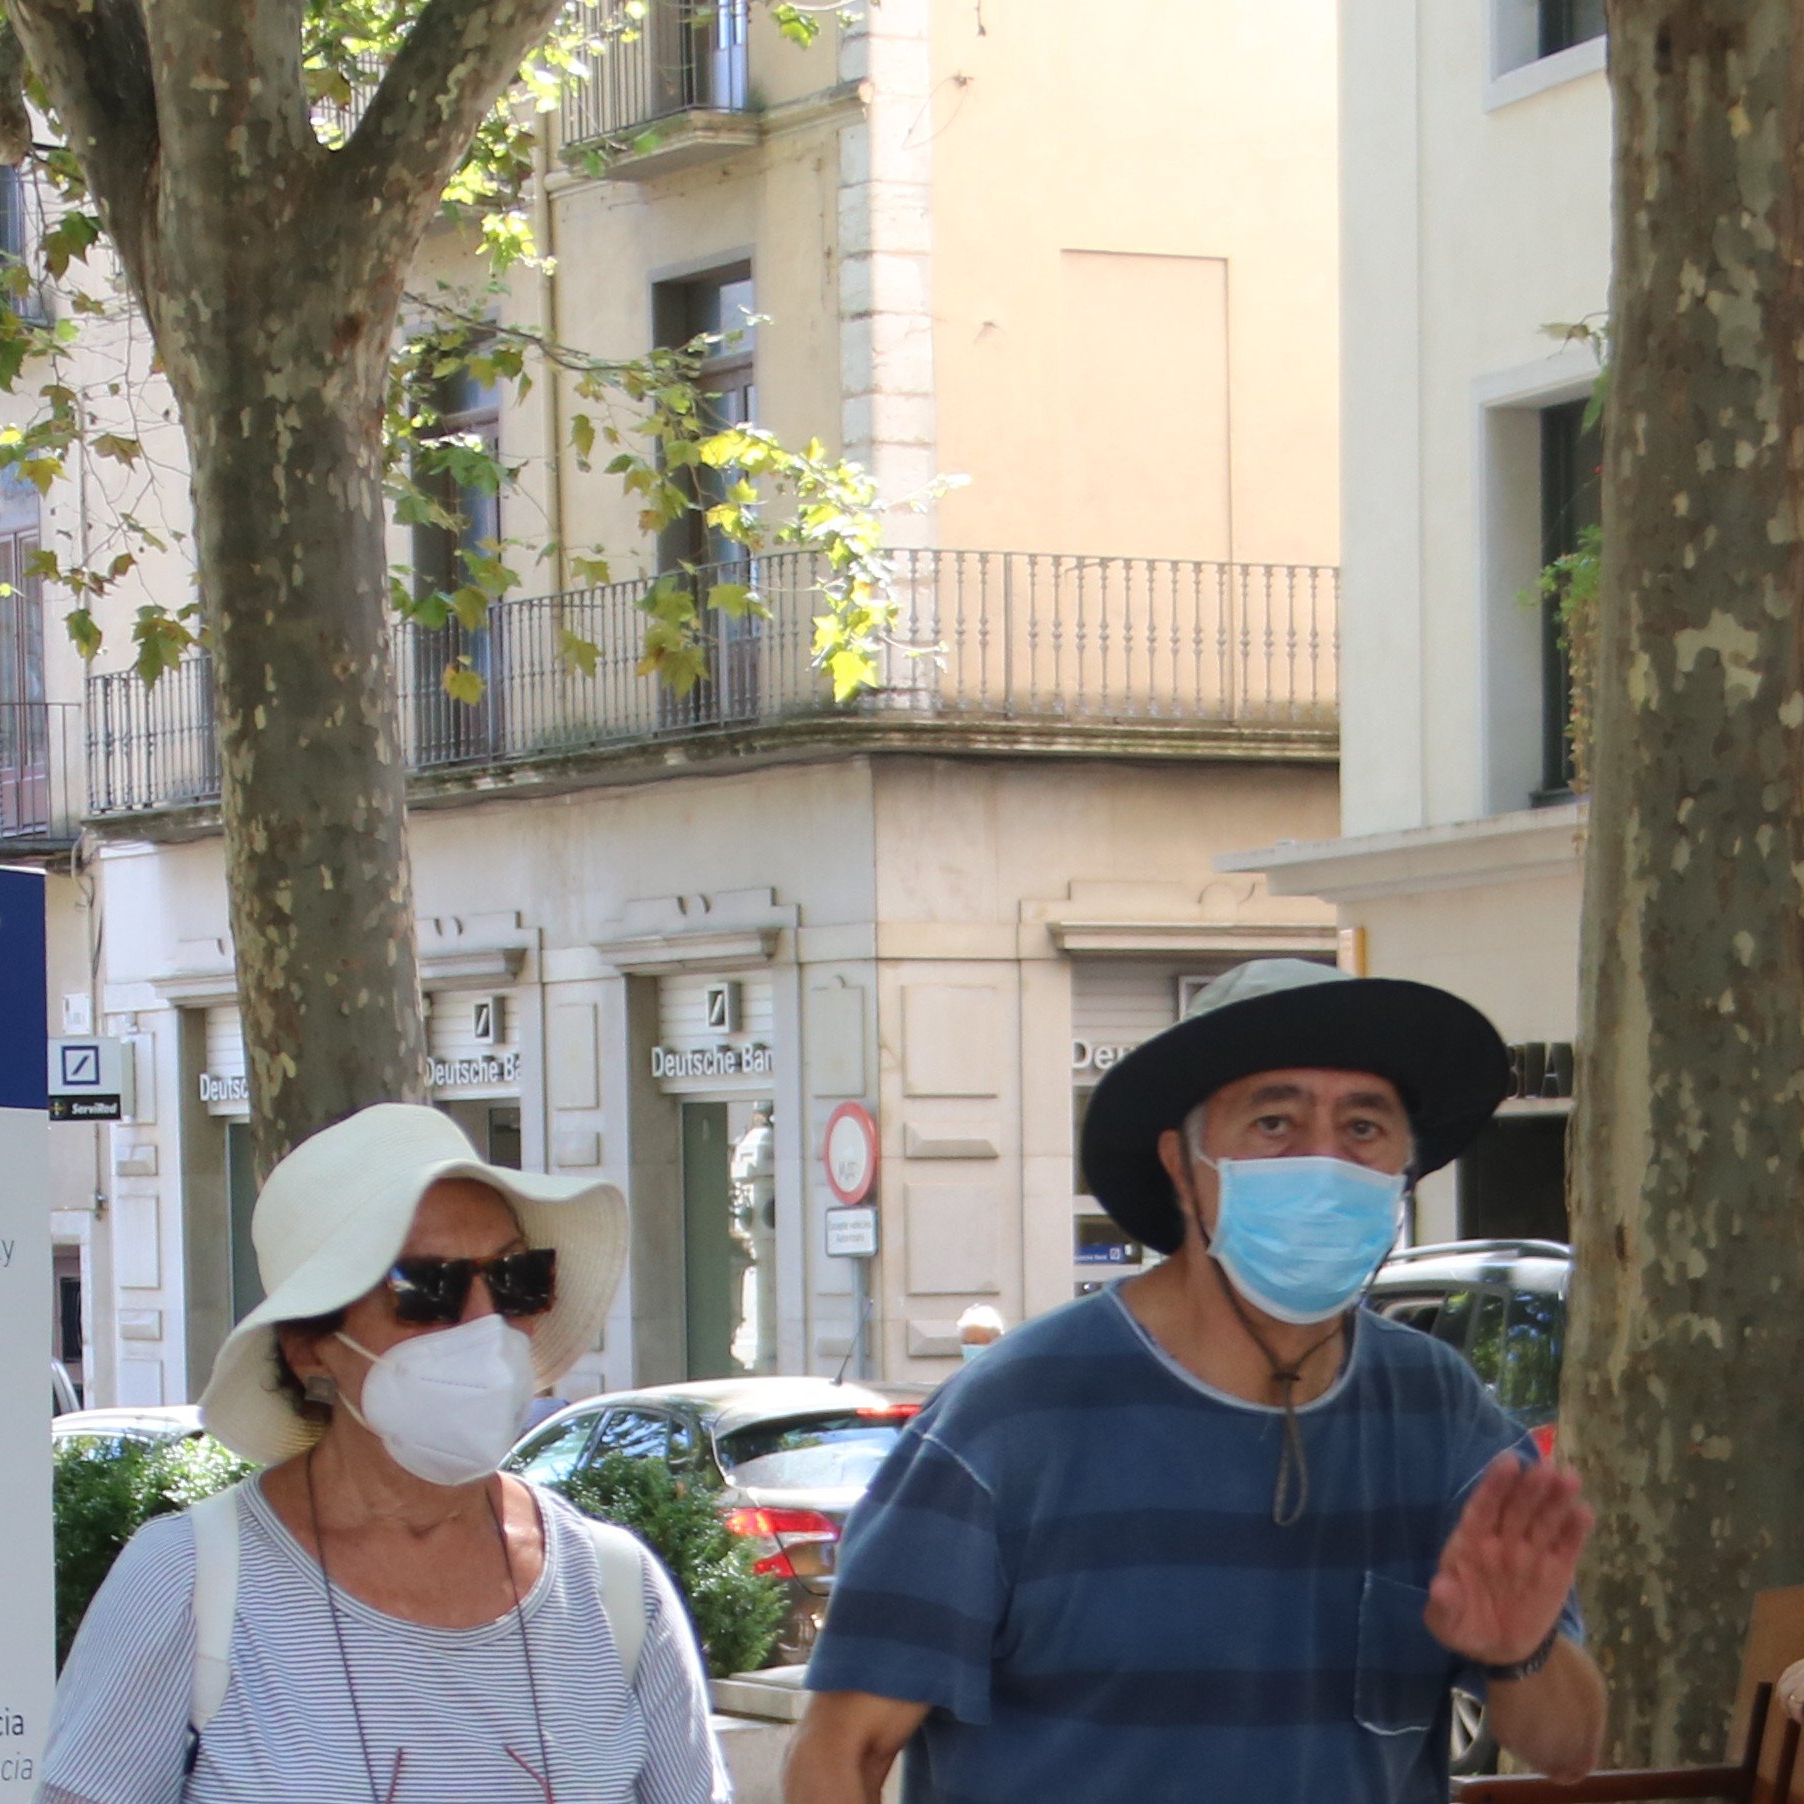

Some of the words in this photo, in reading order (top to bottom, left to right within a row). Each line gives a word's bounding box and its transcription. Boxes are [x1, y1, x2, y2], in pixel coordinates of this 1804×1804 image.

[425, 1055, 498, 1086] Deutsche
[504, 1053, 522, 1081] Ba
[651, 1045, 736, 1078] Deutsche
[741, 1042, 774, 1073] Ban
[199, 1073, 249, 1101] Deutsc
